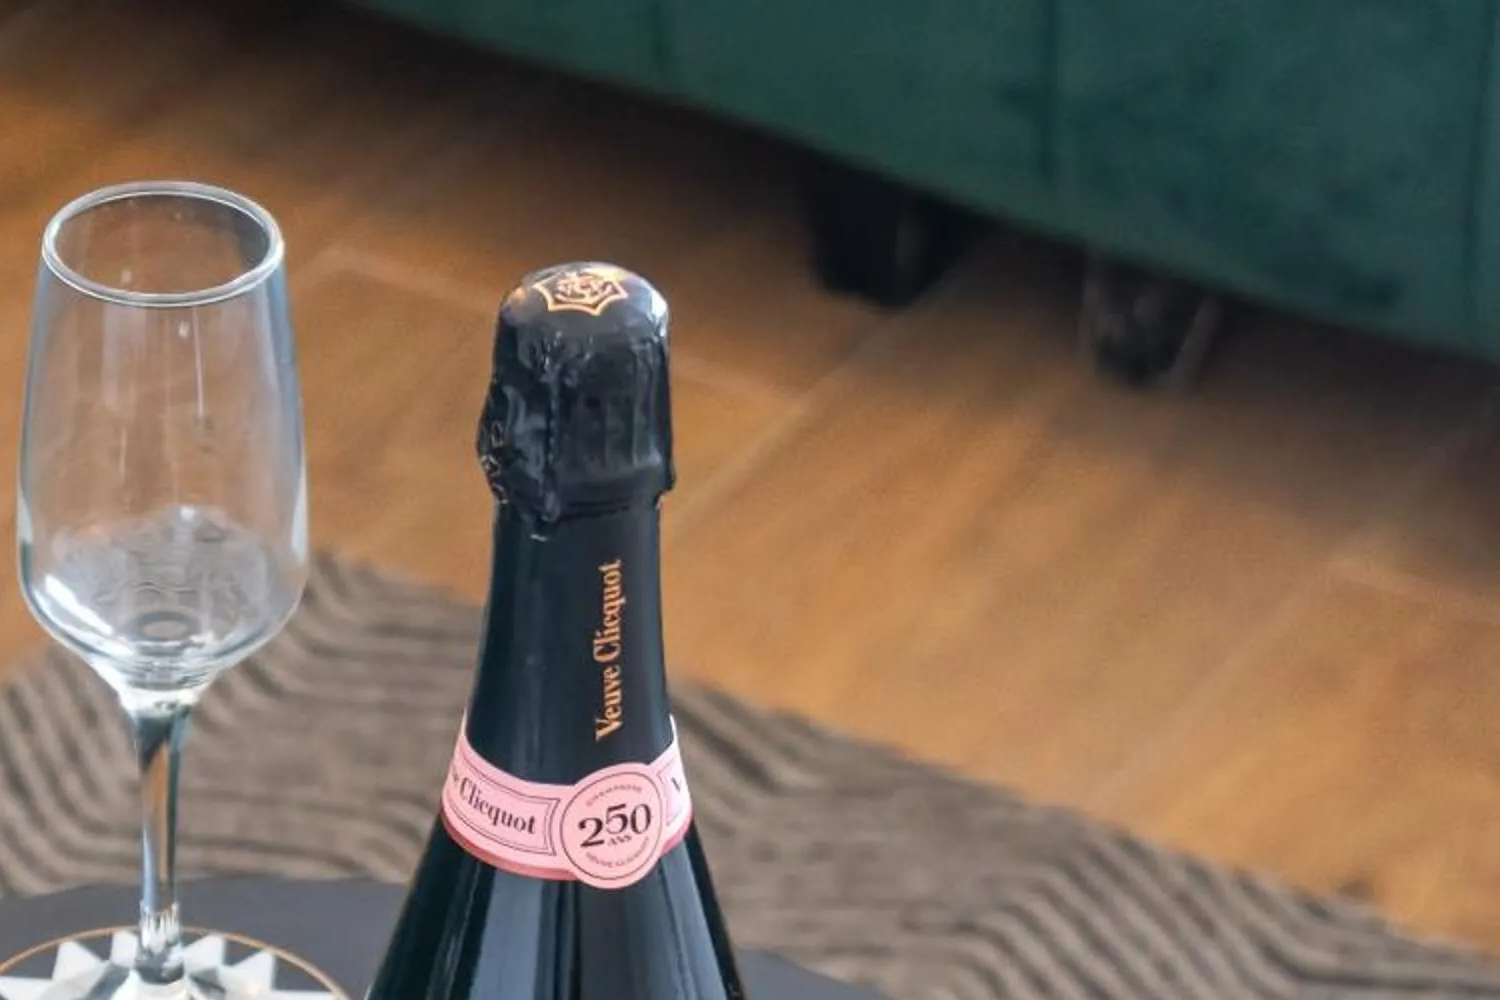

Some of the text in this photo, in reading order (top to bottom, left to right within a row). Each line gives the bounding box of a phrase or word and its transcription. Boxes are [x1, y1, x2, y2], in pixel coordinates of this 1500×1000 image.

[593, 558, 626, 742] Veuve Clicquot
[459, 777, 536, 835] Clicquot
[578, 803, 652, 848] 250
